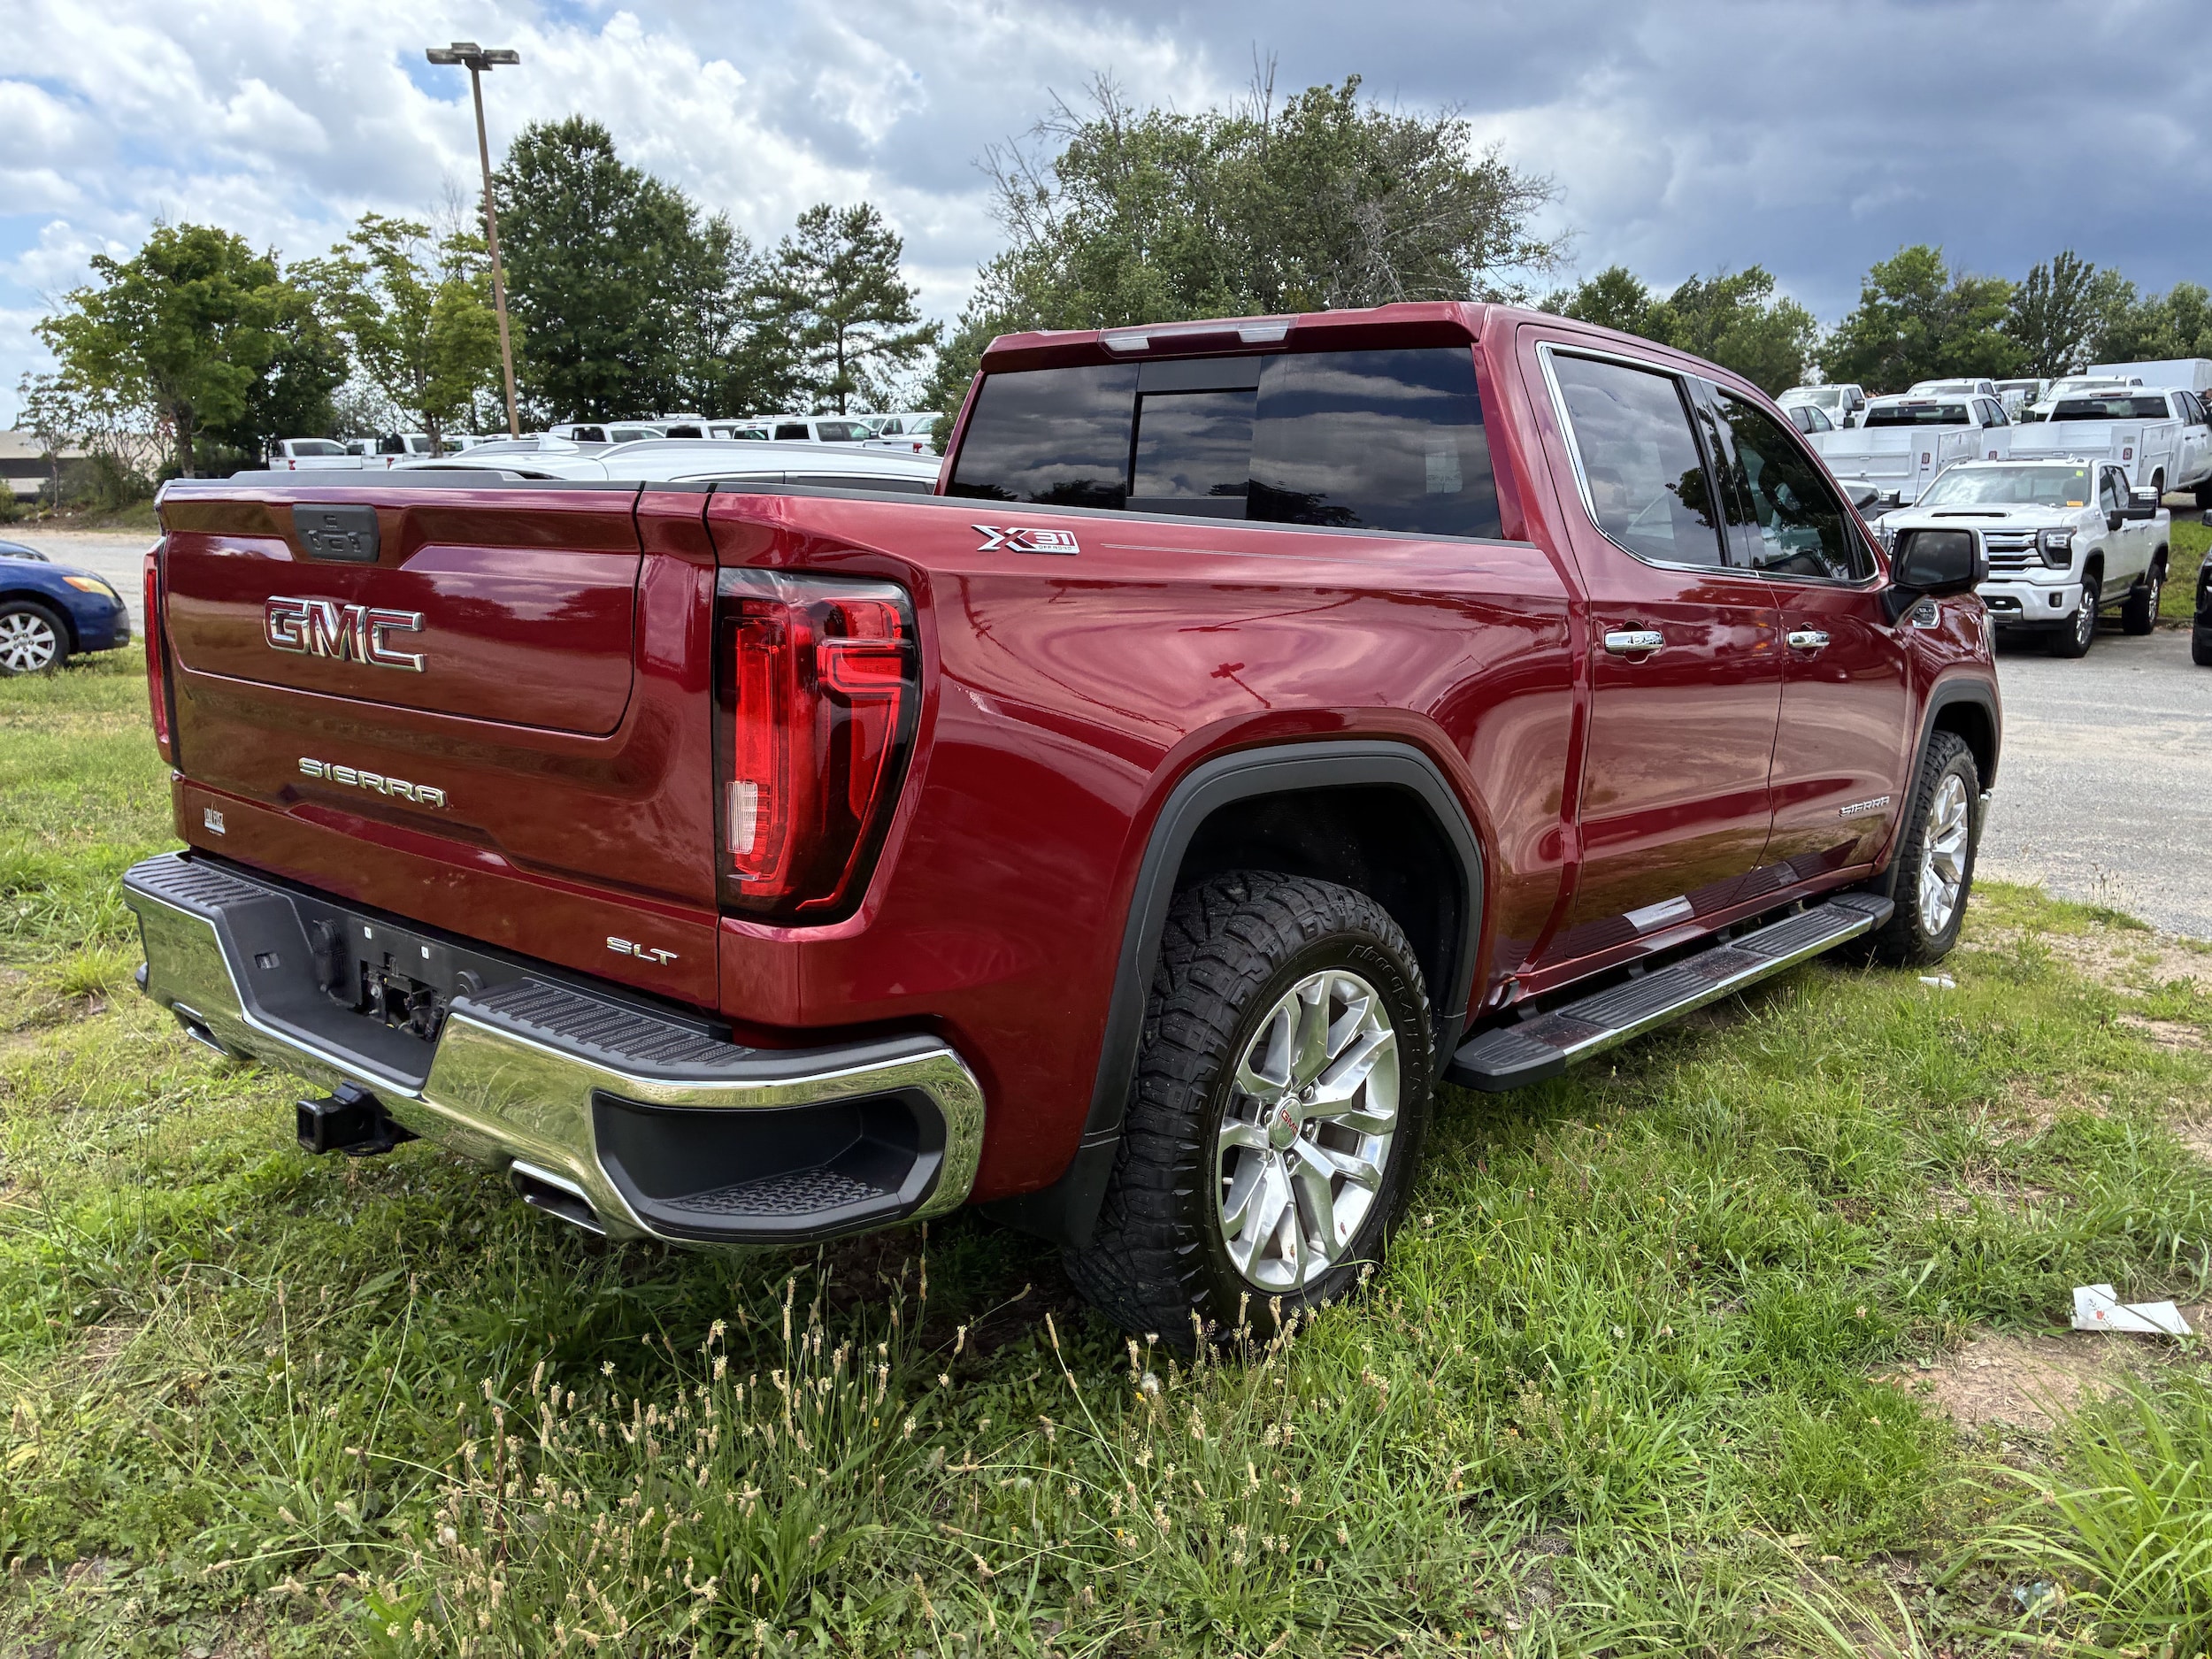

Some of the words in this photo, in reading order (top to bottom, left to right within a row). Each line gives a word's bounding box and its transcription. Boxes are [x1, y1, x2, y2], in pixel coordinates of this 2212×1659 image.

[971, 524, 1080, 554] X31
[263, 595, 425, 672] GMC
[298, 757, 447, 808] SIERRA
[1839, 795, 1890, 817] SIERRA
[606, 936, 678, 966] SLT
[1280, 1109, 1299, 1137] GMC
